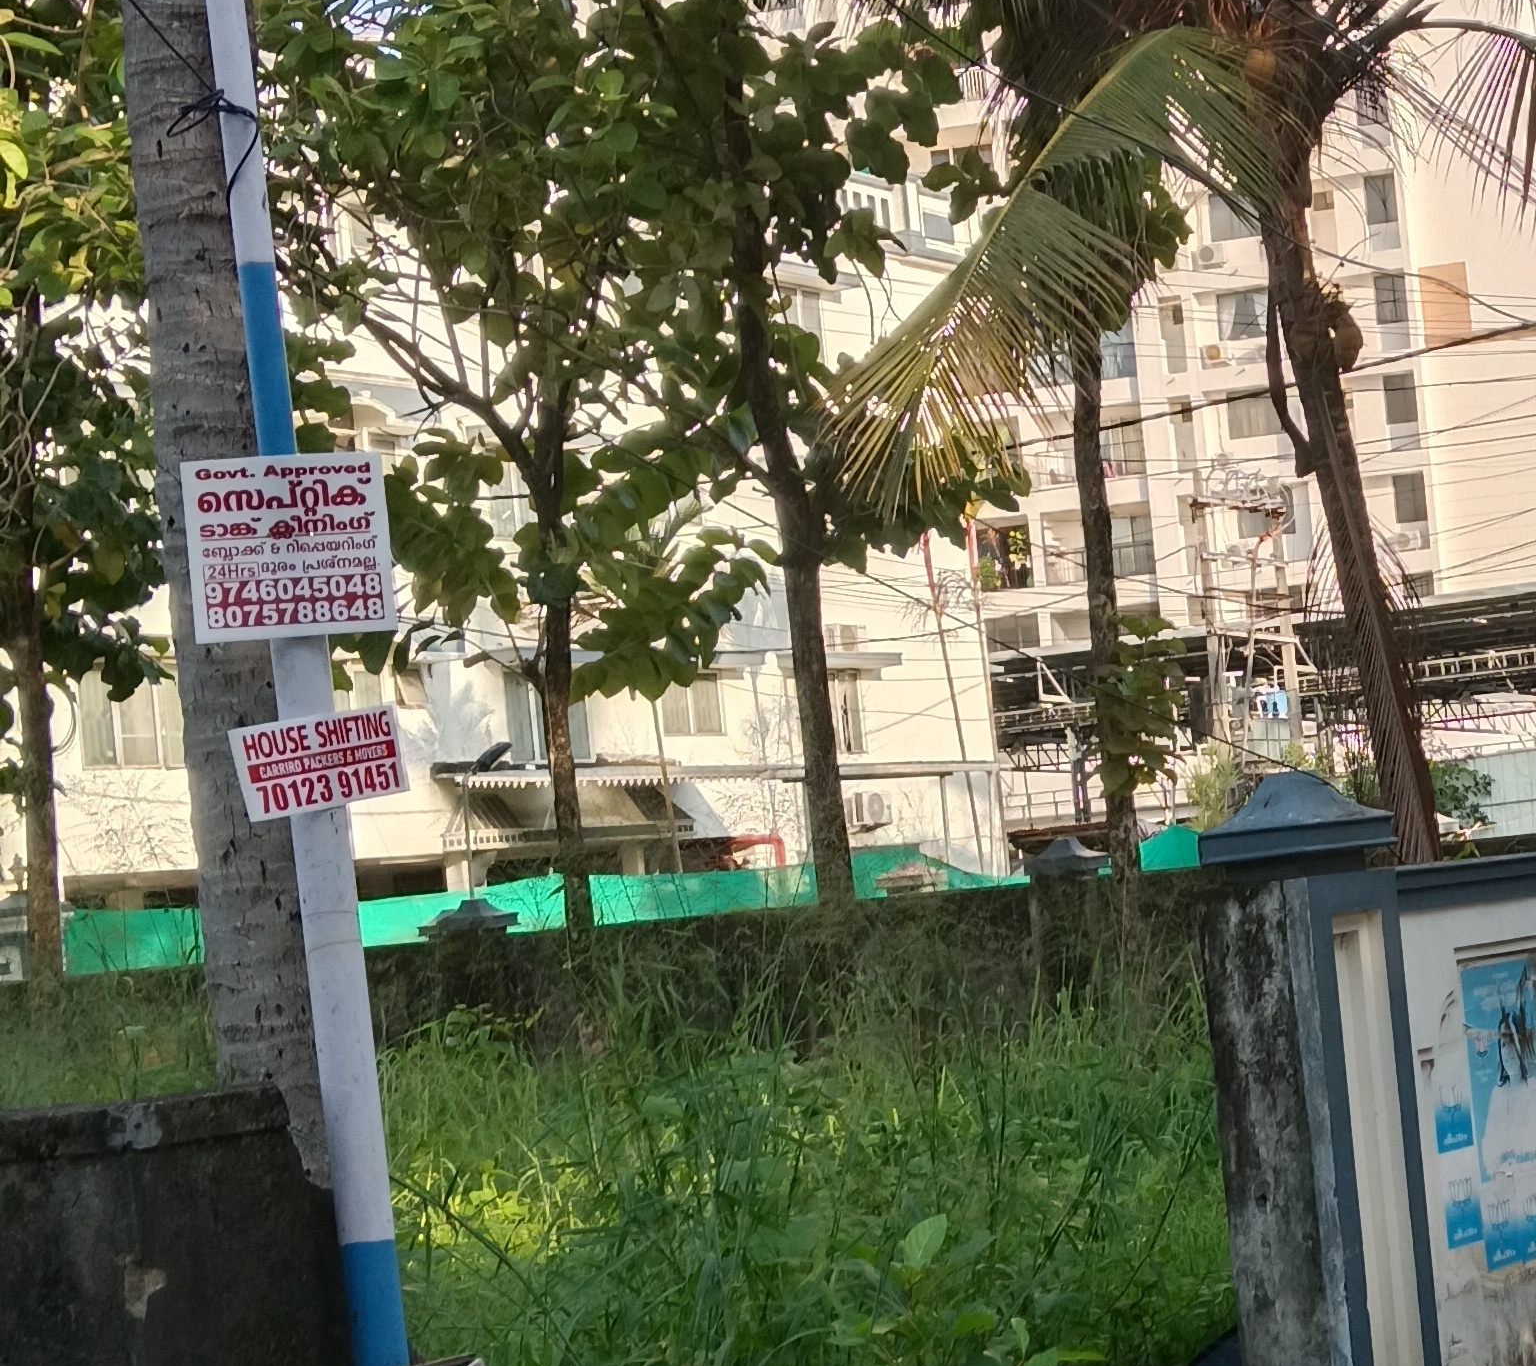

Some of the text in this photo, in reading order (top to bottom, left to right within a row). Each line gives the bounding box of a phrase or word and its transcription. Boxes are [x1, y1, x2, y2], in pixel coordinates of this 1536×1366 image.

[195, 466, 256, 481] Govt.
[207, 564, 256, 579] 24Hrs
[205, 573, 381, 605] 9746045048
[208, 597, 384, 629] 8075788648
[242, 710, 392, 762] HOUSE SHIFTING
[303, 750, 345, 770] PACKERS
[256, 761, 400, 814] 70123 91451
